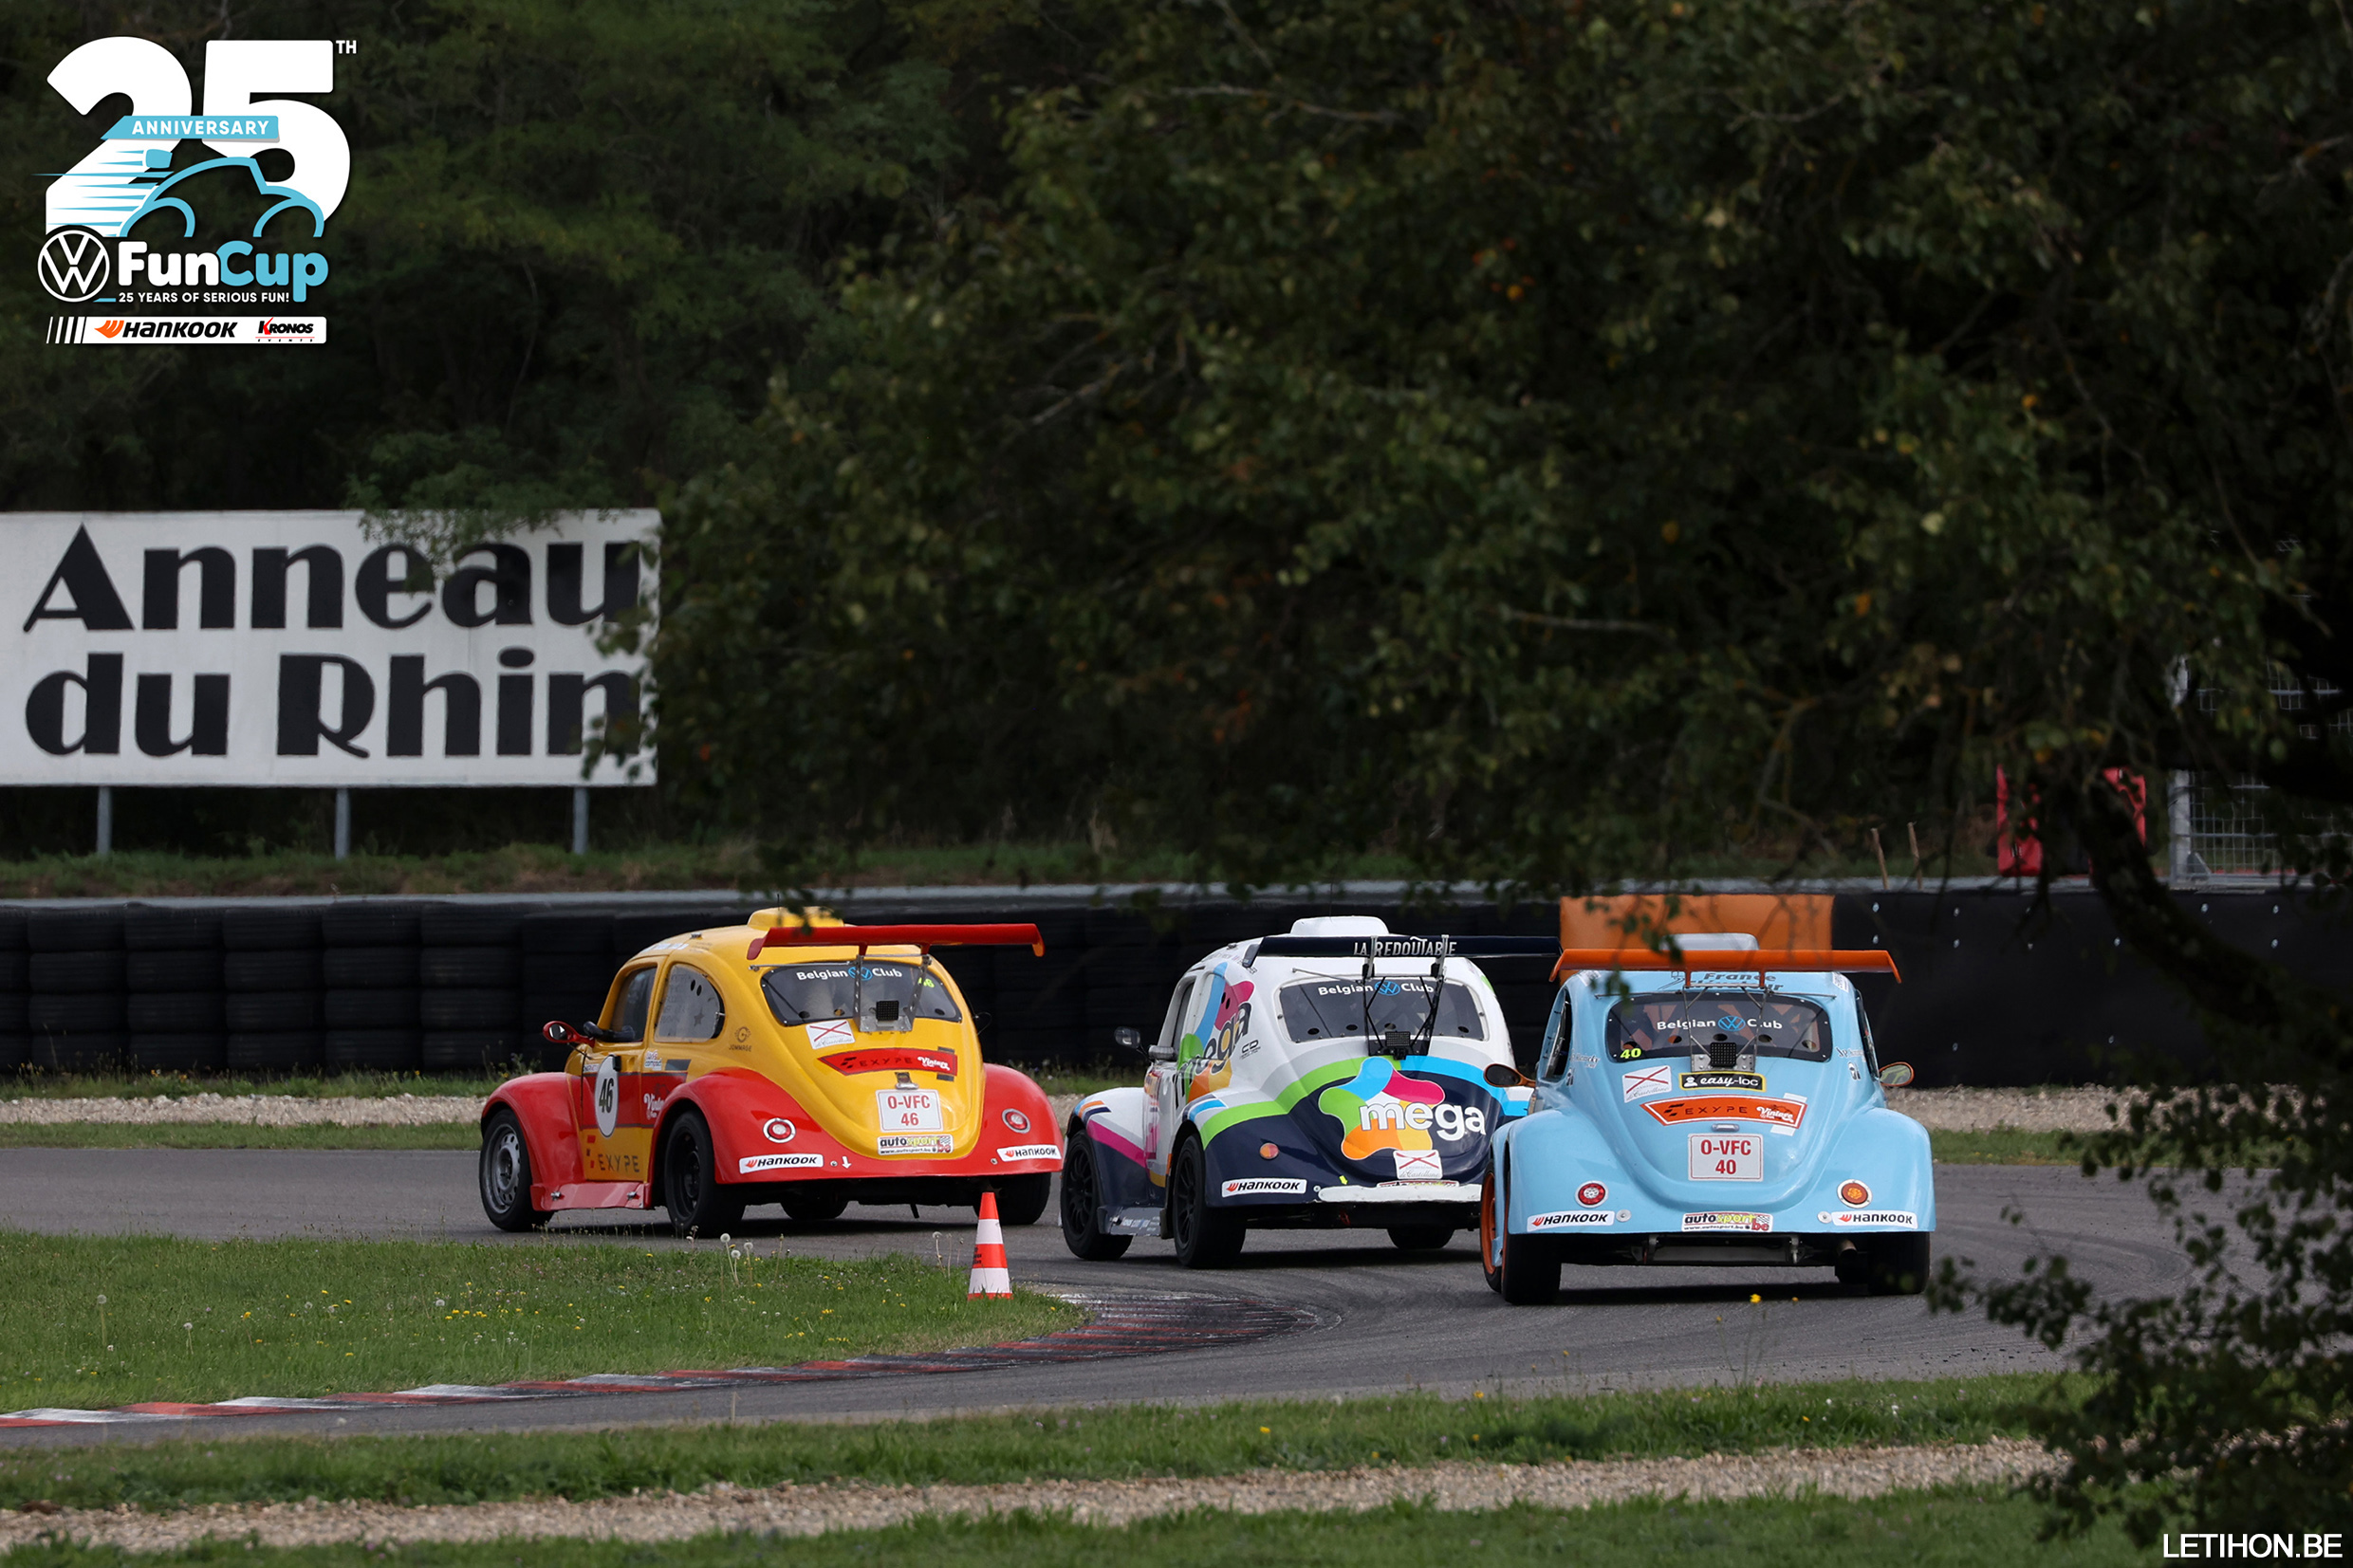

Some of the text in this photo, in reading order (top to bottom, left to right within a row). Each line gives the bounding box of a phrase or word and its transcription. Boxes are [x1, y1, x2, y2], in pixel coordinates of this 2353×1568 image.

[24, 523, 642, 633] Anneau
[25, 647, 641, 758] du Rhin
[1354, 942, 1369, 955] LA
[796, 969, 848, 980] Belgian
[872, 968, 902, 978] Club
[1318, 983, 1373, 995] Belgian
[1401, 983, 1434, 993] Club
[1657, 1020, 1715, 1029] Belgian
[1747, 1019, 1783, 1029] Cub
[1621, 1048, 1641, 1059] 40
[860, 1057, 913, 1066] EXYPE
[1700, 1075, 1758, 1088] easy-loc
[599, 1078, 615, 1114] 46
[1686, 1106, 1748, 1115] EXYPE
[901, 1112, 919, 1126] 46
[1359, 1101, 1487, 1141] mega
[599, 1153, 640, 1172] EXYPE
[1715, 1159, 1736, 1174] 40
